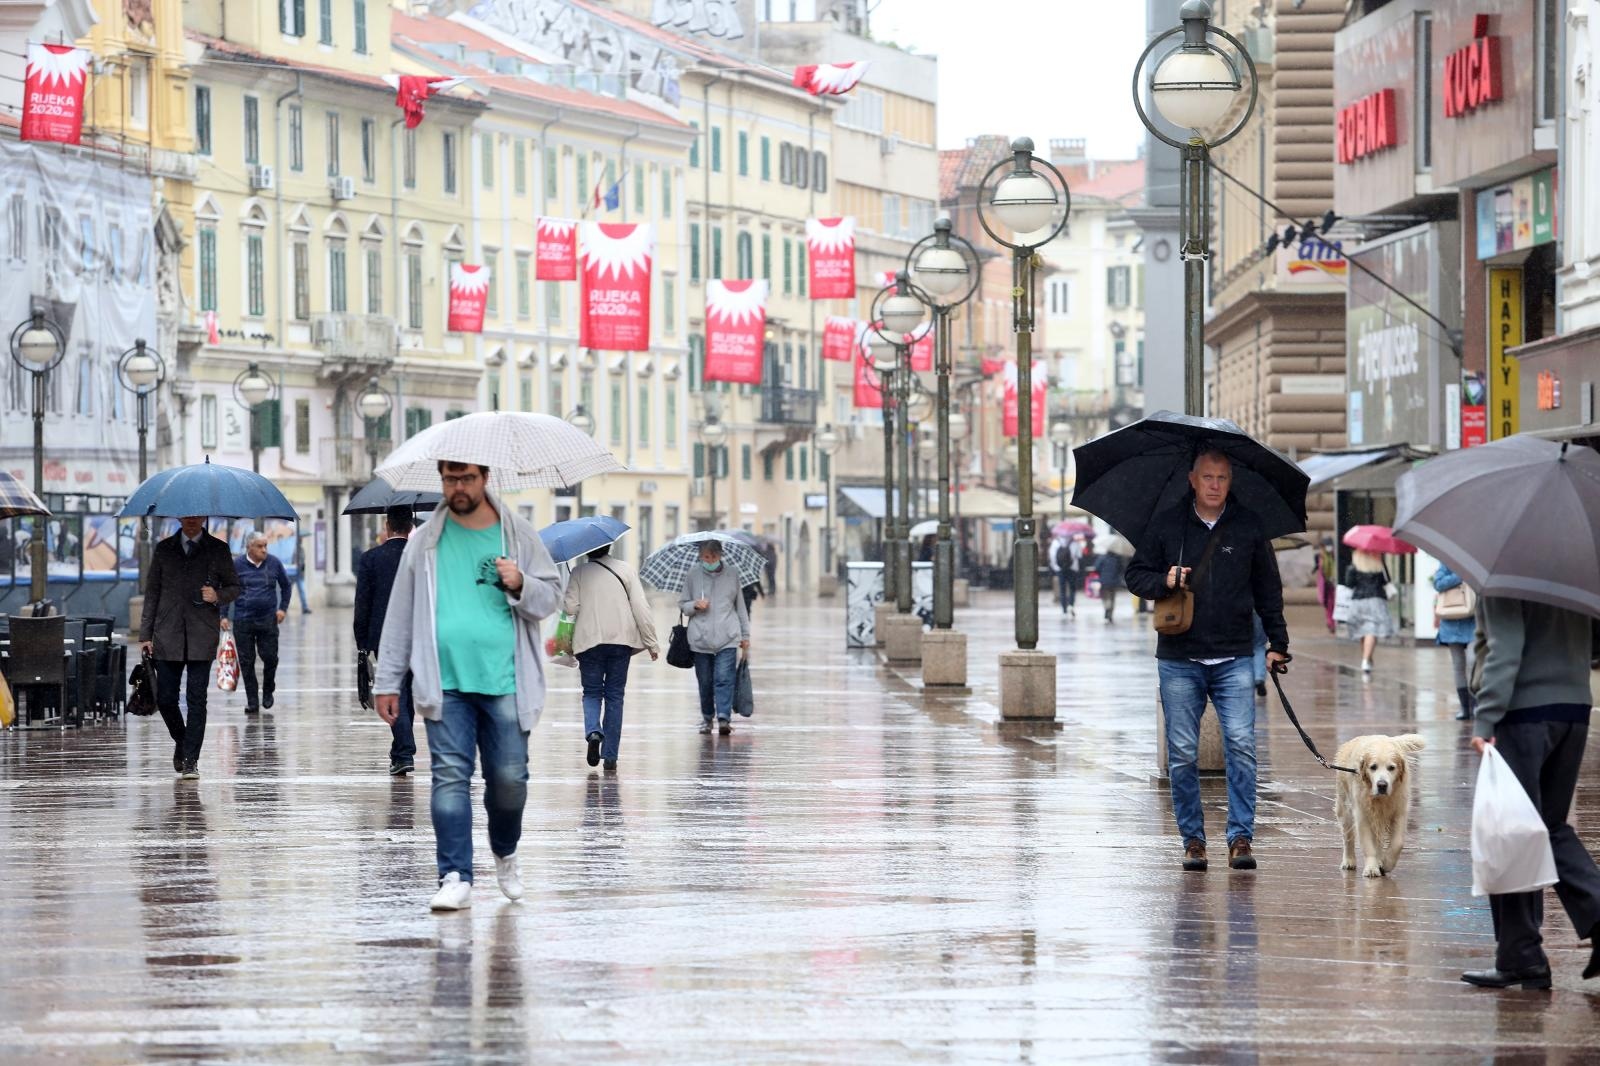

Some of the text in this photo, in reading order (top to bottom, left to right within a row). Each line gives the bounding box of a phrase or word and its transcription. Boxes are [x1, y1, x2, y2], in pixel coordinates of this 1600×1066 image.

[1336, 14, 1502, 164] ROBNA KUĆA
[30, 92, 75, 107] RIJEKA
[589, 289, 641, 303] RIJEKA
[711, 331, 757, 345] RIJEKA
[1501, 279, 1511, 386] HAPPY
